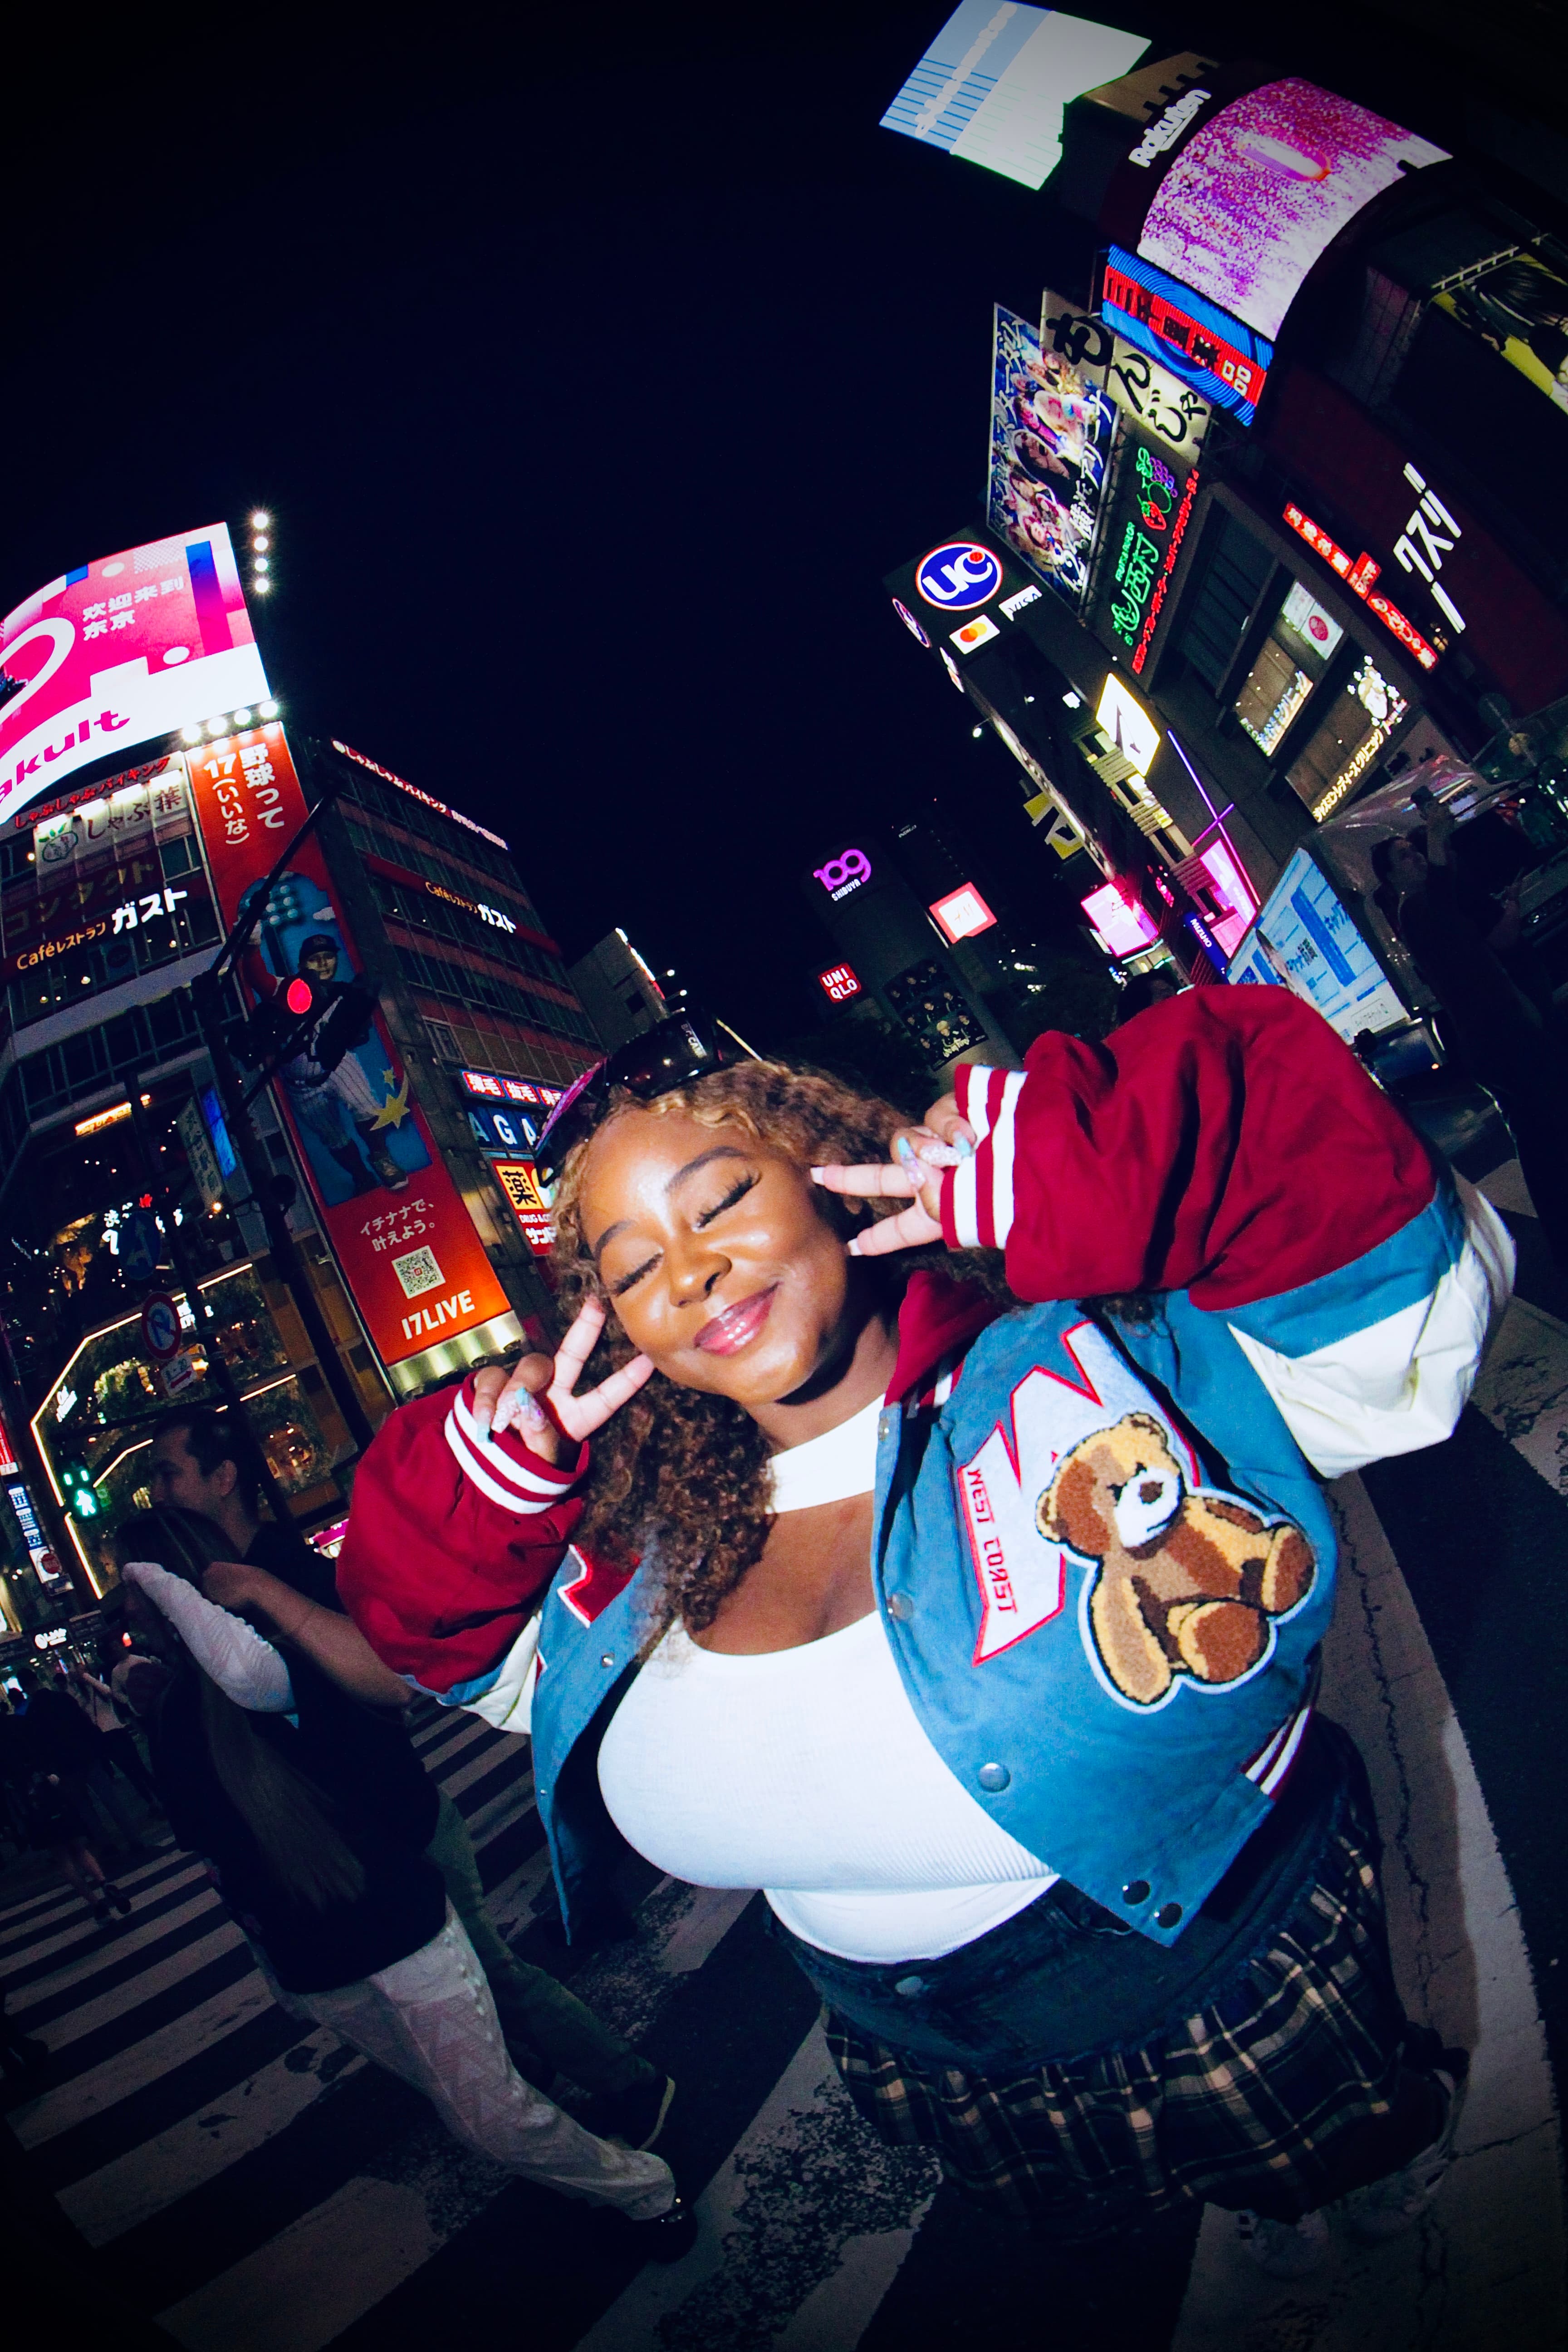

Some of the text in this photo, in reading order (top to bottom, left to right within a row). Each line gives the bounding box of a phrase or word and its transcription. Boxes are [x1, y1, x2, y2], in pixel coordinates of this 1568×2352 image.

[1128, 89, 1211, 167] Rakuten
[1393, 490, 1462, 582] クスリ
[922, 550, 993, 600] UC
[1124, 532, 1159, 604] 西村
[83, 576, 184, 622] 欢迎来到
[83, 609, 136, 641] 东京
[15, 757, 171, 828] しゃぶしゃぶバイキング
[240, 743, 284, 829] 野球って
[88, 784, 181, 839] しゃぶ葉
[813, 849, 872, 892] 109
[831, 878, 861, 902] SHIBUYA
[112, 888, 187, 935] ガスト
[477, 903, 516, 933] ガスト
[1190, 918, 1212, 948] MIZUHO
[822, 967, 849, 987] UNI
[830, 979, 858, 1000] QLO
[503, 1171, 537, 1205] 薬
[360, 1198, 434, 1235] イチナナで、
[372, 1219, 435, 1252] 叶えよう。
[519, 1214, 537, 1224] DRUG
[401, 1289, 475, 1340] 17LIVE
